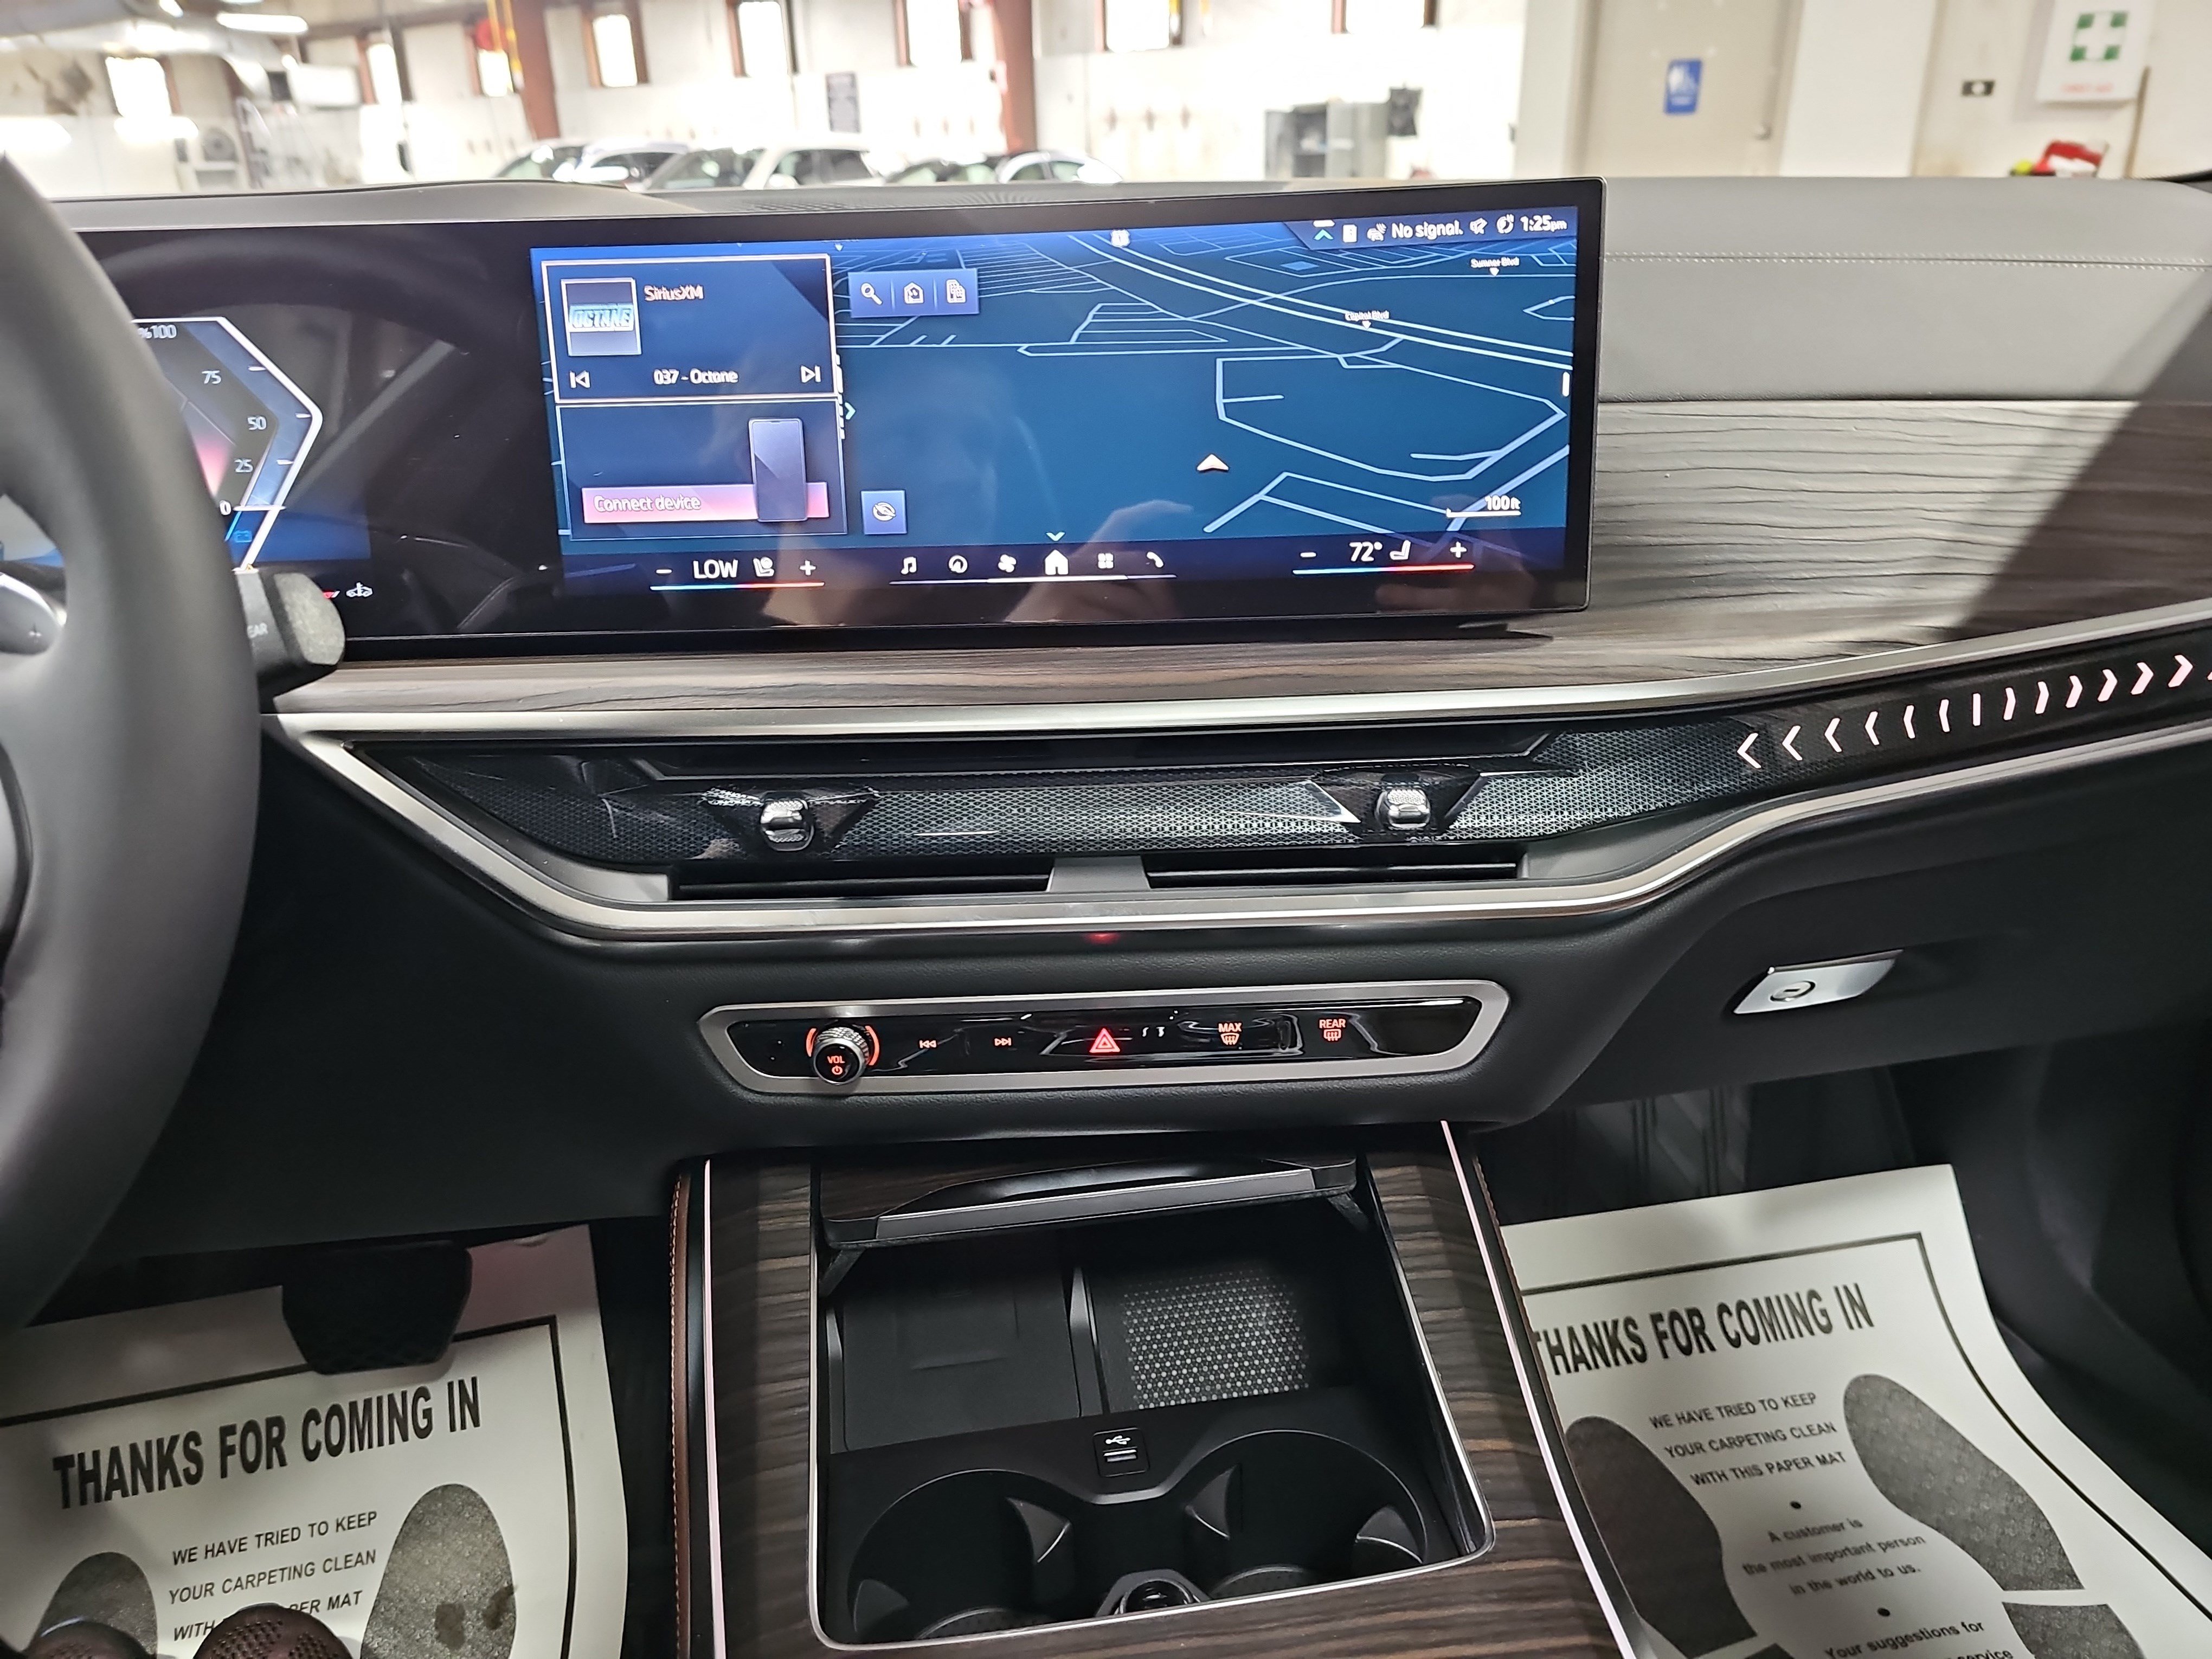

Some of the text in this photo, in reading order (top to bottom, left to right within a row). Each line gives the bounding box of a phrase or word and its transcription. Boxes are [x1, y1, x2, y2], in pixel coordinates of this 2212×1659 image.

[1392, 220, 1463, 240] No signal.
[644, 285, 703, 300] SiriusXM
[202, 370, 222, 384] 75
[654, 369, 679, 384] 037
[690, 368, 738, 384] Octane
[247, 416, 266, 430] 50
[234, 459, 253, 473] 25
[220, 500, 232, 515] 0
[594, 494, 701, 512] Connect device
[693, 558, 738, 578] LOW
[1218, 1023, 1242, 1032] MAX
[1320, 1019, 1346, 1028] REAR
[827, 1056, 845, 1064] VOL
[1533, 1283, 1875, 1375] HANKS FOR COMING IN
[1649, 1392, 1817, 1429] WE HAVE TRIED TO KEEP
[52, 1376, 481, 1509] THANKS FOR COMING IN
[1664, 1422, 1838, 1458] YOUR CARPETING CLEAN
[1689, 1451, 1847, 1486] WITH THIS PAPER MAT
[172, 1511, 377, 1566] WE HAVE TRIED TO KEEP
[1768, 1518, 1863, 1544] A customer is
[1742, 1535, 1926, 1575] the most important person
[169, 1549, 376, 1605] YOUR CARPETING CLEAN
[1807, 1579, 1832, 1592] the
[1835, 1568, 1876, 1587] world
[1877, 1567, 1894, 1578] to
[1897, 1564, 1921, 1574] us.
[174, 1619, 215, 1641] WITH
[327, 1590, 363, 1611] MAT
[1824, 1621, 1985, 1659] Your suggestions for
